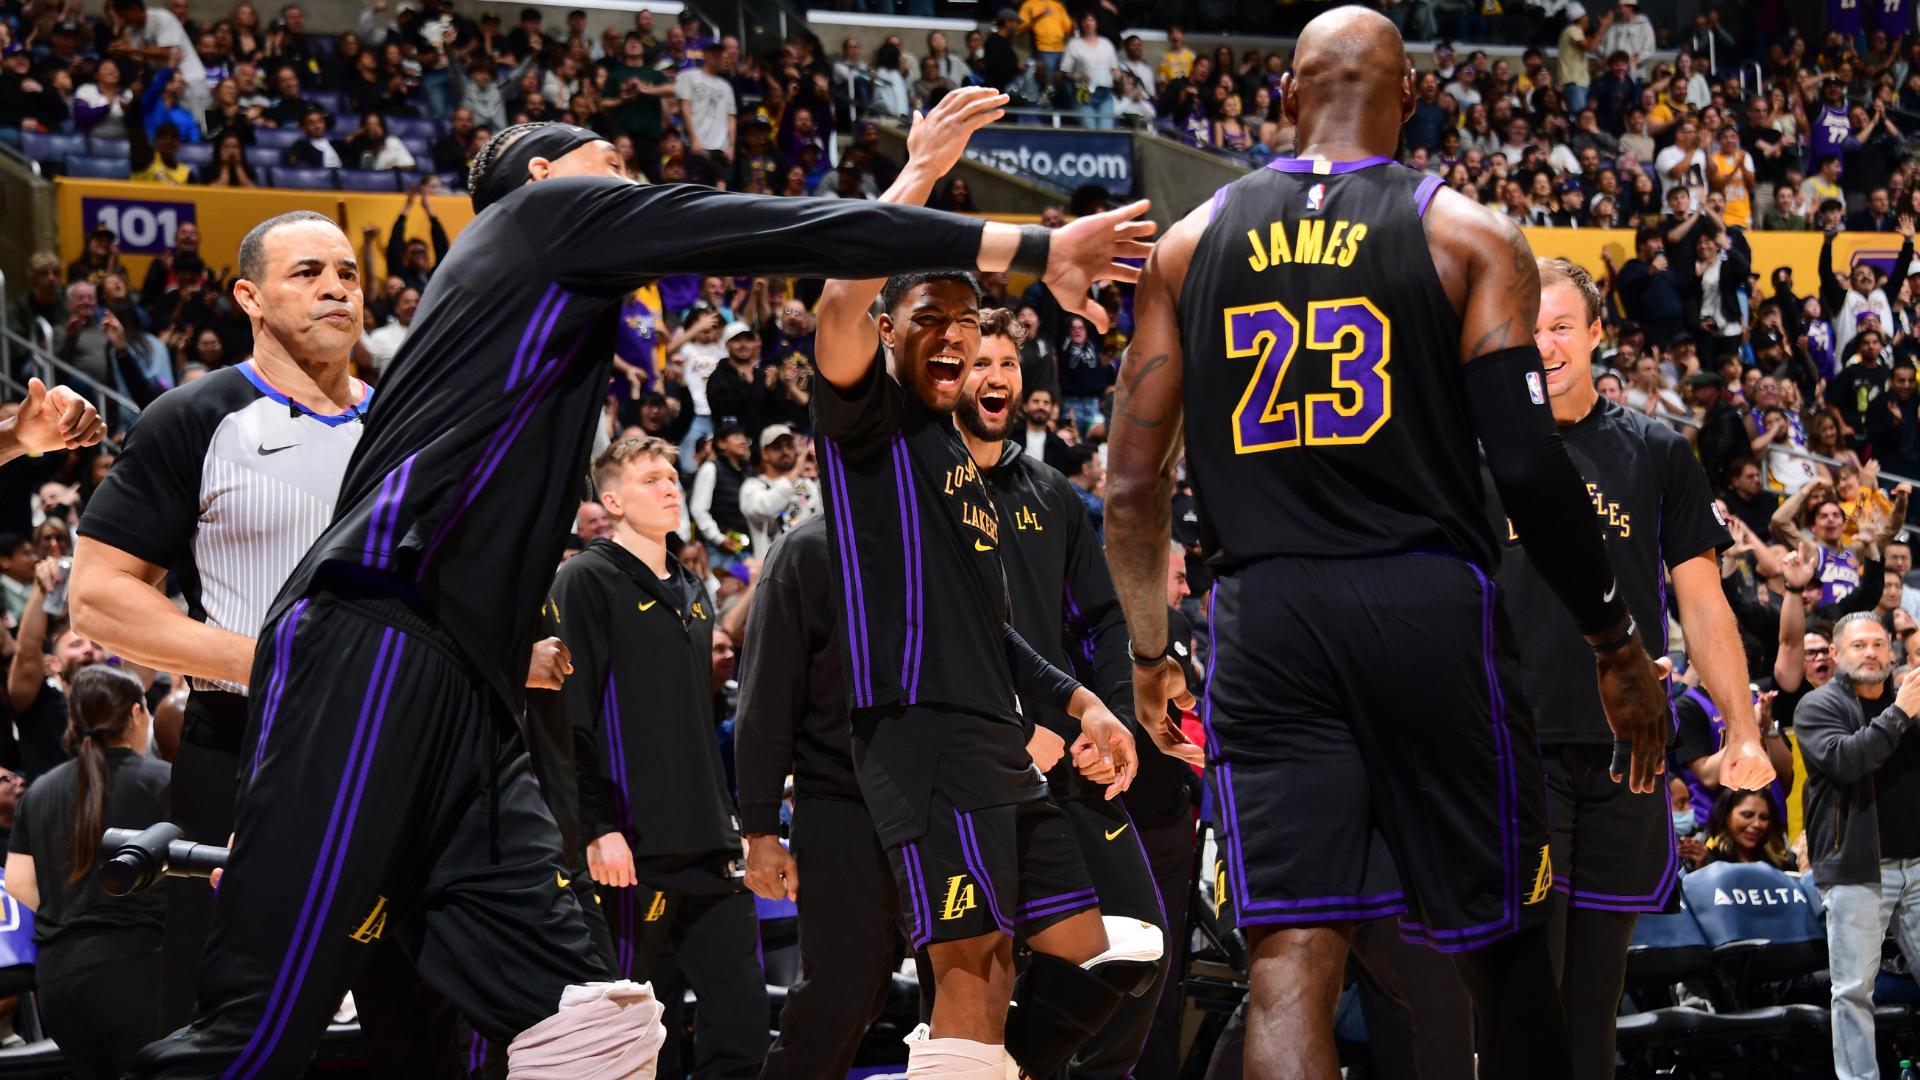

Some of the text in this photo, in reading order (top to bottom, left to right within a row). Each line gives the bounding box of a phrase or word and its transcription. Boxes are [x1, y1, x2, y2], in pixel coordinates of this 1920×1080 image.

[97, 205, 178, 248] 101
[1247, 219, 1368, 272] JAMES
[1223, 296, 1391, 455] 23
[1015, 505, 1043, 531] LAL
[1586, 483, 1631, 538] ELES
[348, 895, 389, 943] LA
[938, 874, 977, 920] LA
[1732, 888, 1808, 905] DELTA
